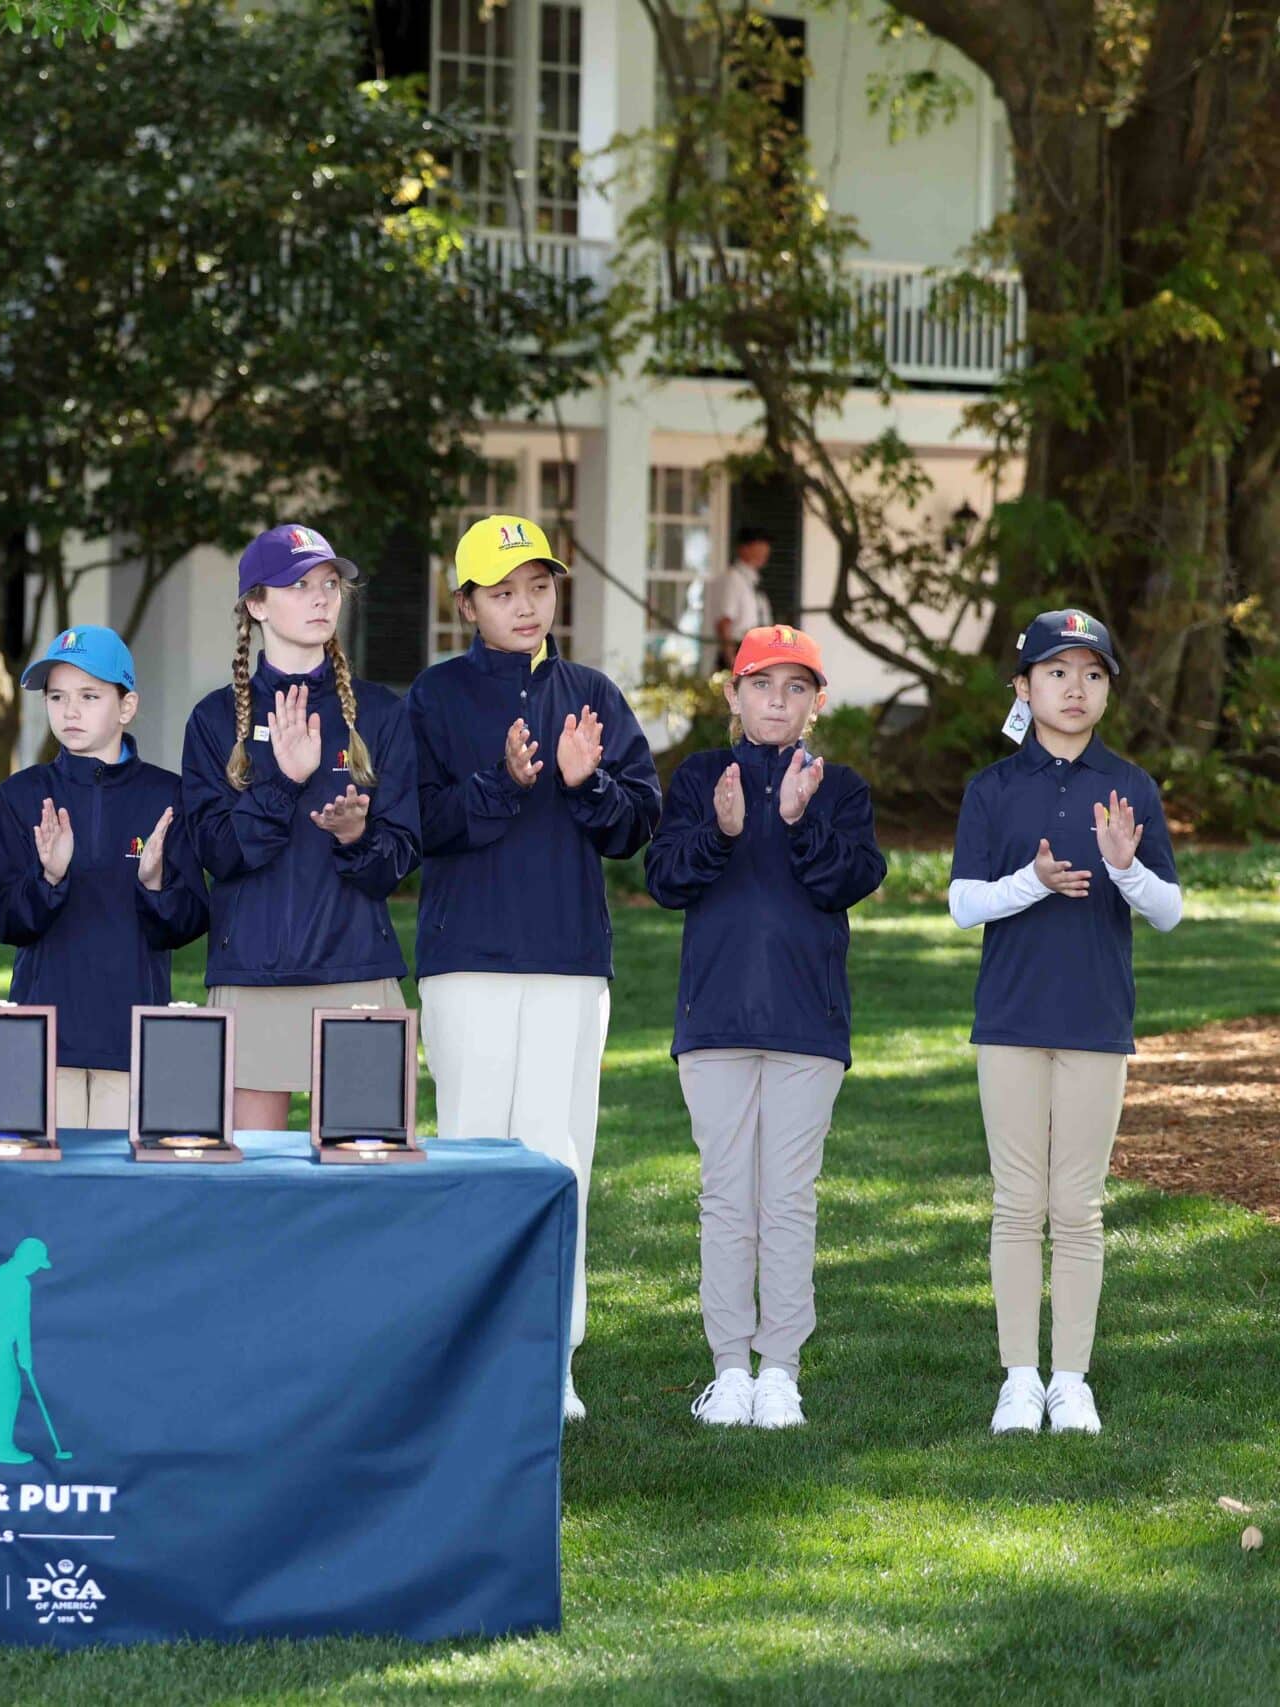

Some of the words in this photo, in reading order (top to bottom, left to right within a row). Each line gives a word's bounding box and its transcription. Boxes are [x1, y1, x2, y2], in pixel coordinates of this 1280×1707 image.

[19, 1483, 118, 1513] PUTT
[26, 1577, 107, 1600] PGA
[35, 1601, 50, 1611] OF
[51, 1601, 98, 1611] AMERICA
